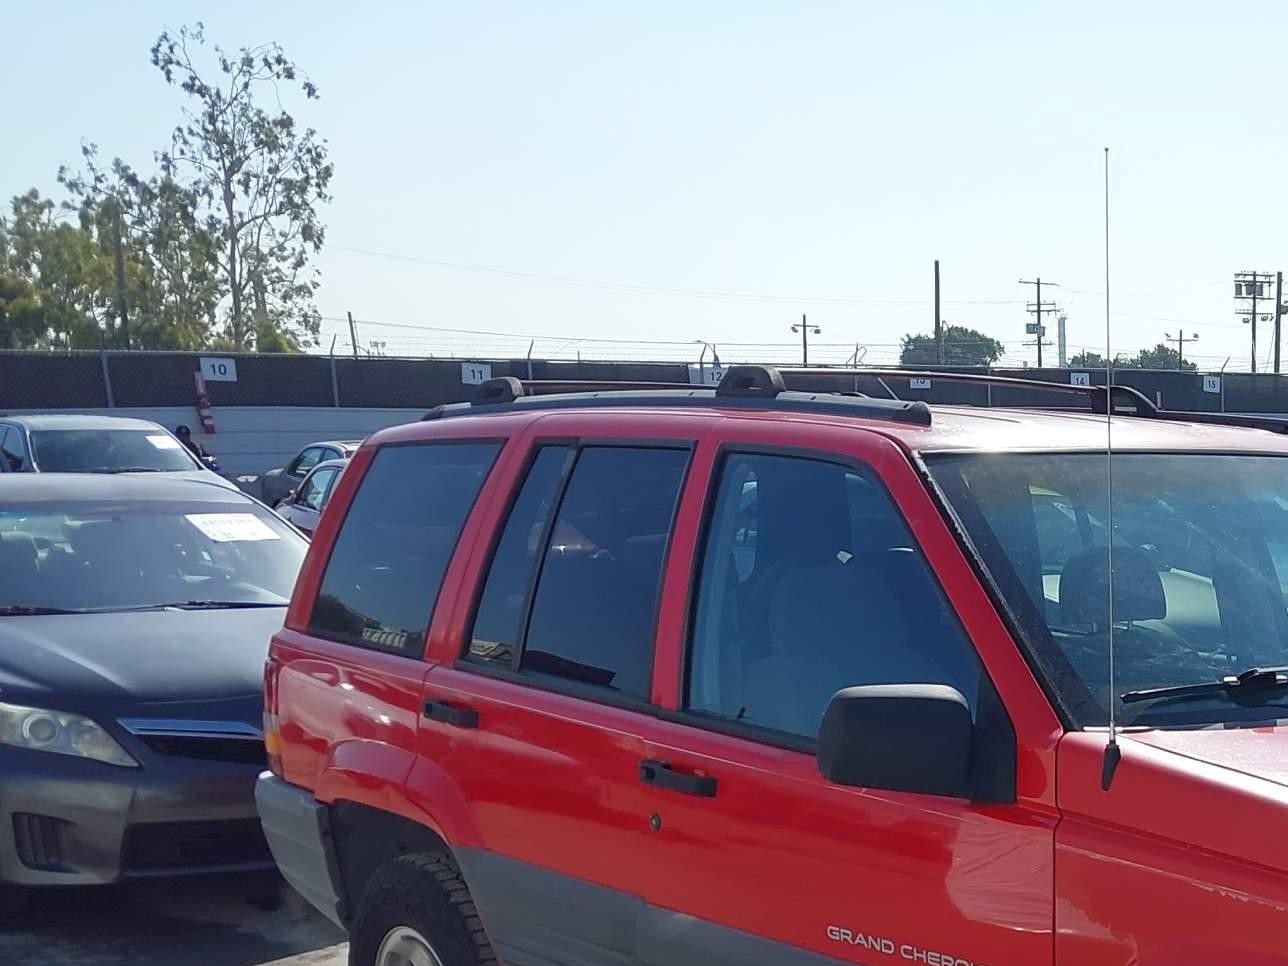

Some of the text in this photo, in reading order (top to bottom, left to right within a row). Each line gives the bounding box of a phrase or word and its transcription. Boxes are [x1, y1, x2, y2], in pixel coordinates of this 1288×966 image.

[210, 363, 227, 376] 10
[470, 369, 483, 380] 11
[710, 371, 722, 381] 12
[1207, 380, 1216, 389] 15
[826, 925, 895, 955] GRAND
